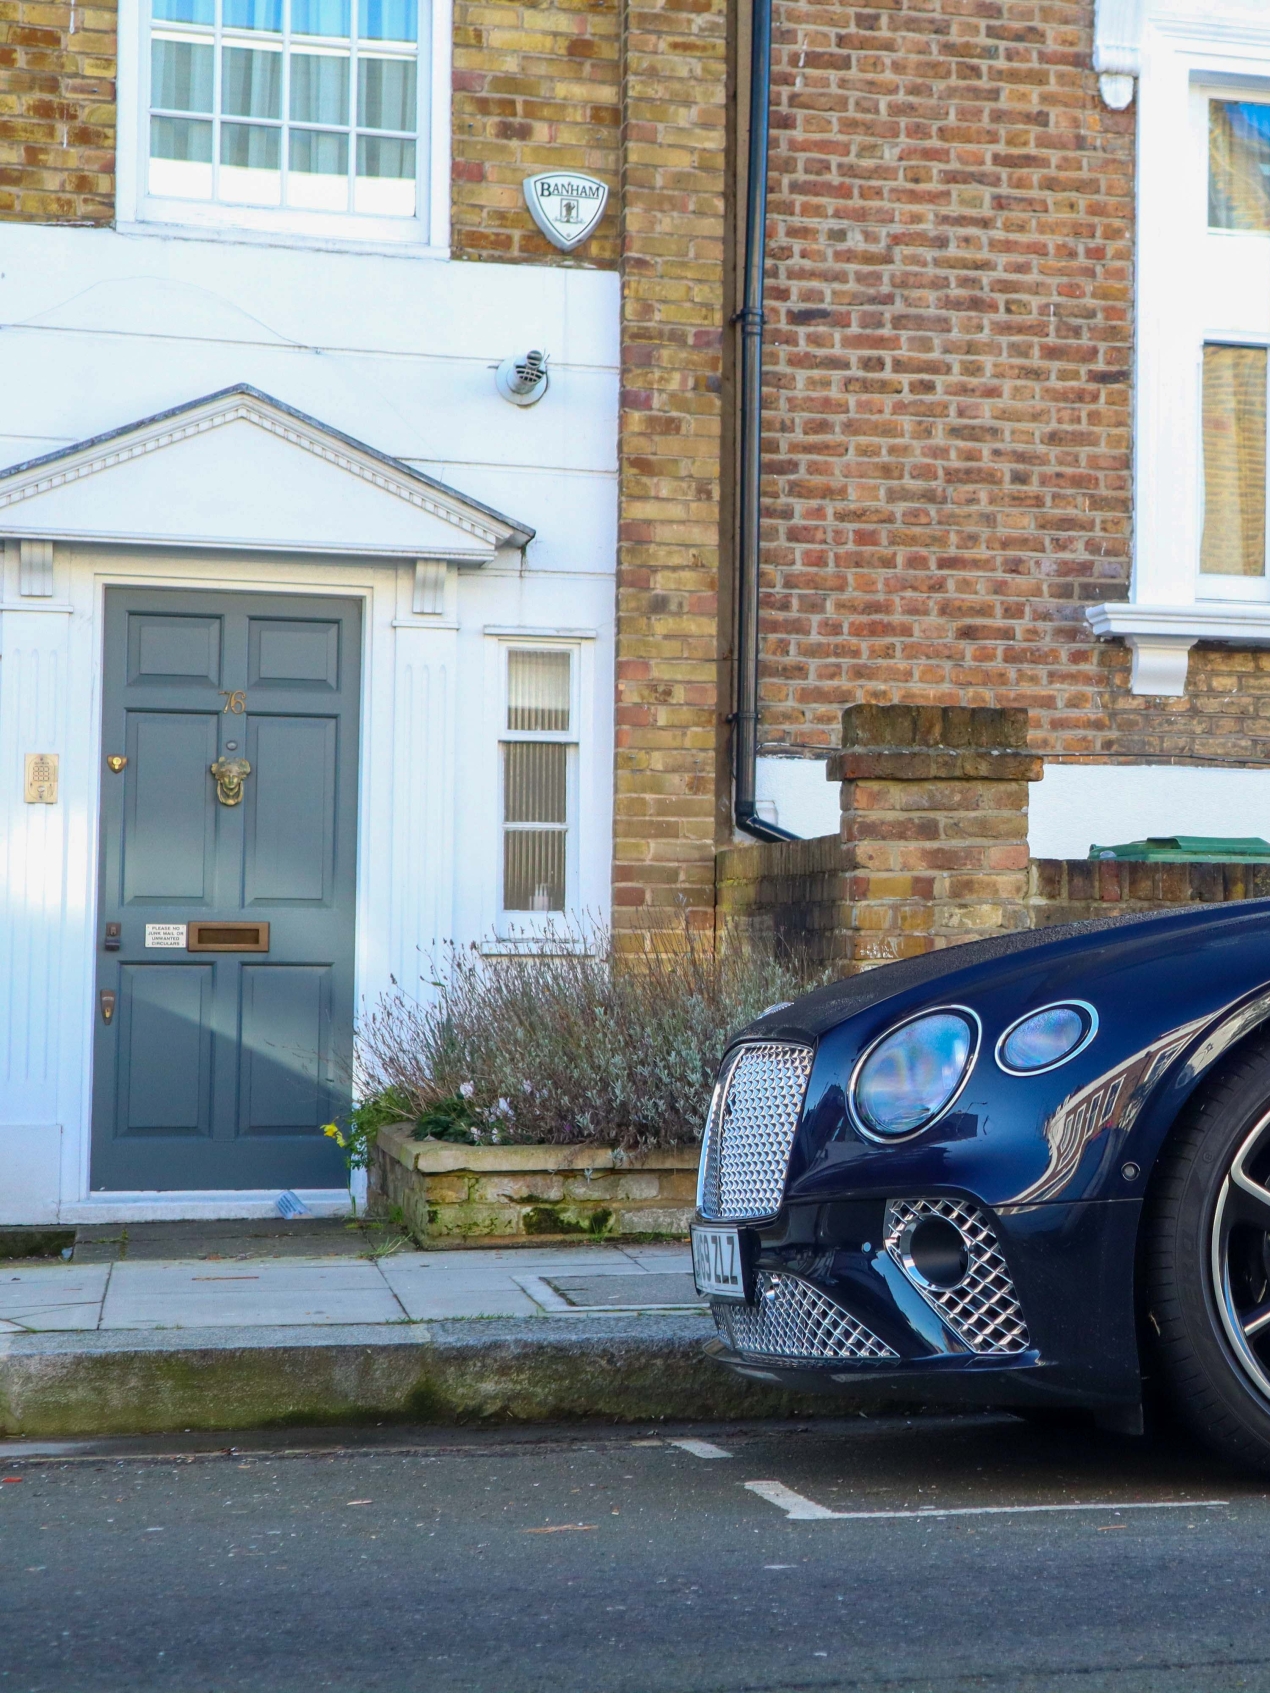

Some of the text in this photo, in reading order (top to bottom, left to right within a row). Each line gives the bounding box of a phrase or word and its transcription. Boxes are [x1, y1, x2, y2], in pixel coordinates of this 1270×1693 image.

[540, 181, 600, 198] BANHAM
[217, 690, 246, 714] 76
[711, 1235, 738, 1285] ZLZ
